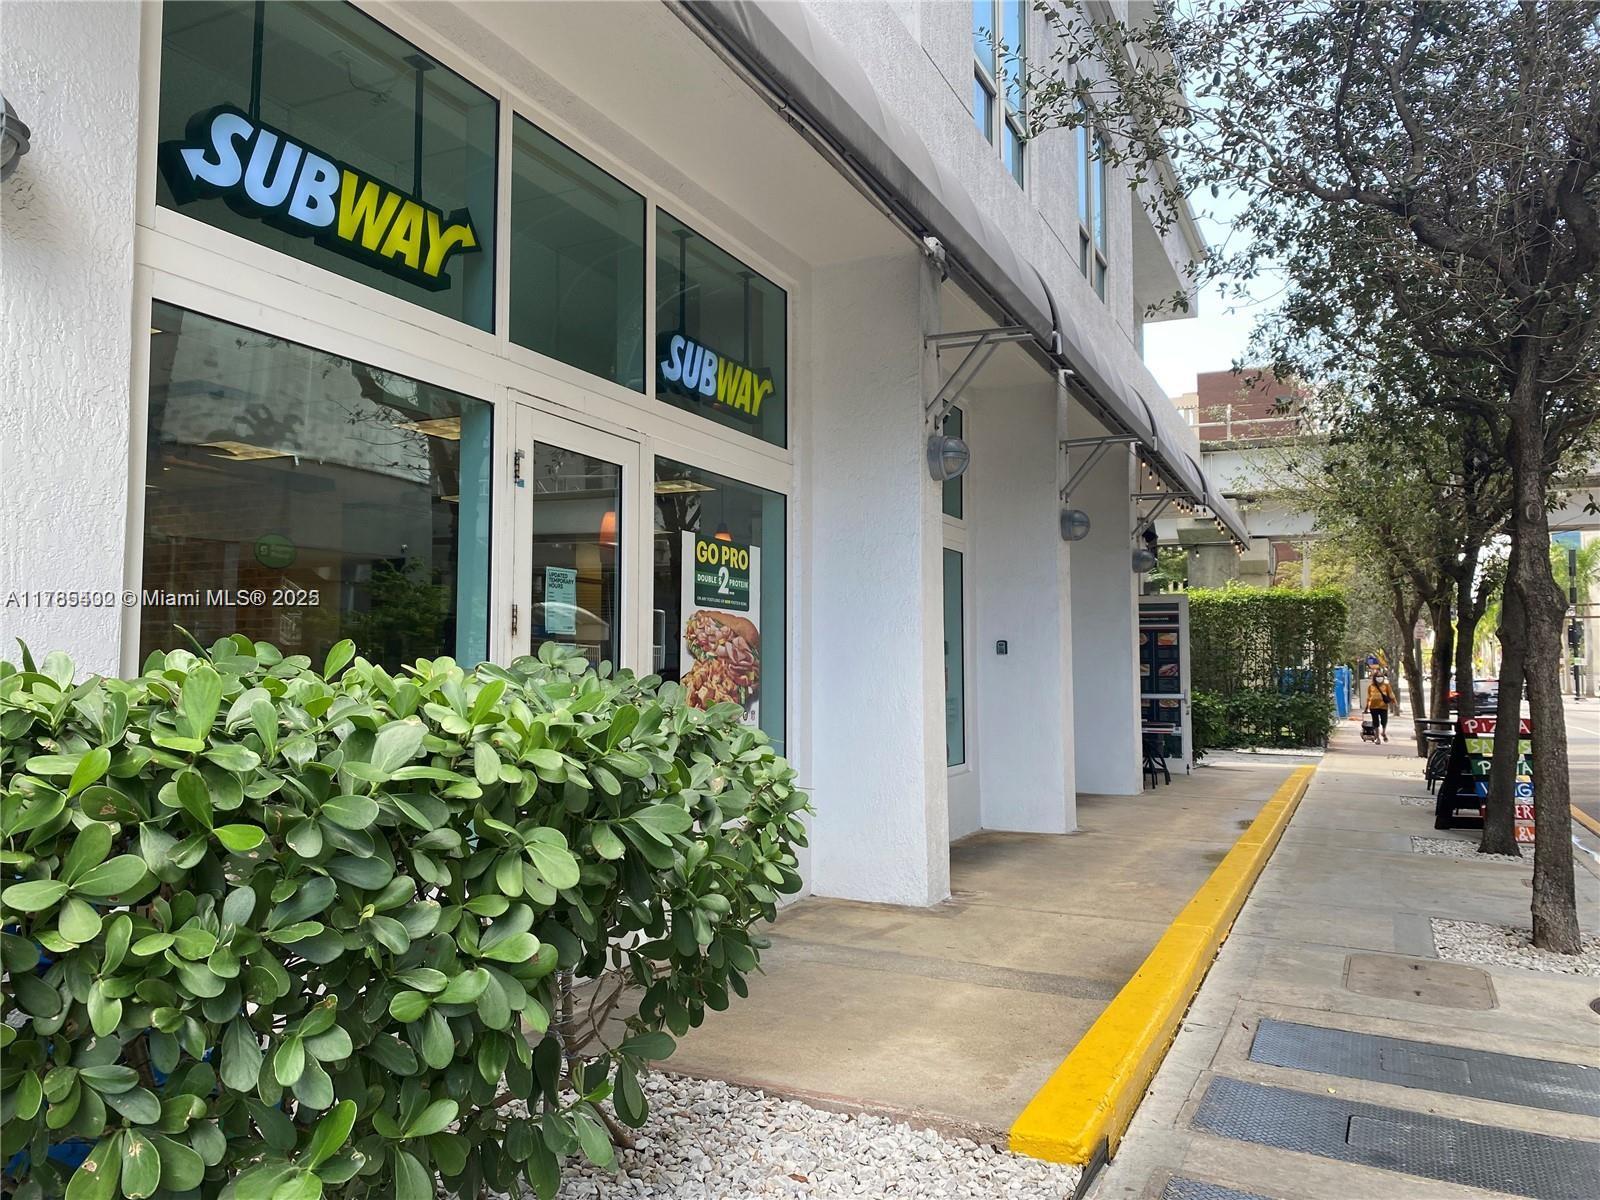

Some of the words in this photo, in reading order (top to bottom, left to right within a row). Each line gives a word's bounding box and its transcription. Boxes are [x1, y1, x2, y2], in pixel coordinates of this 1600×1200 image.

[180, 112, 476, 277] SUBWAY
[661, 334, 774, 417] SUBWAY
[697, 540, 719, 565] GO
[721, 545, 749, 571] PRO
[697, 573, 717, 585] DOUBLE
[729, 578, 749, 589] PROTEIN
[1464, 719, 1532, 734] PIZA
